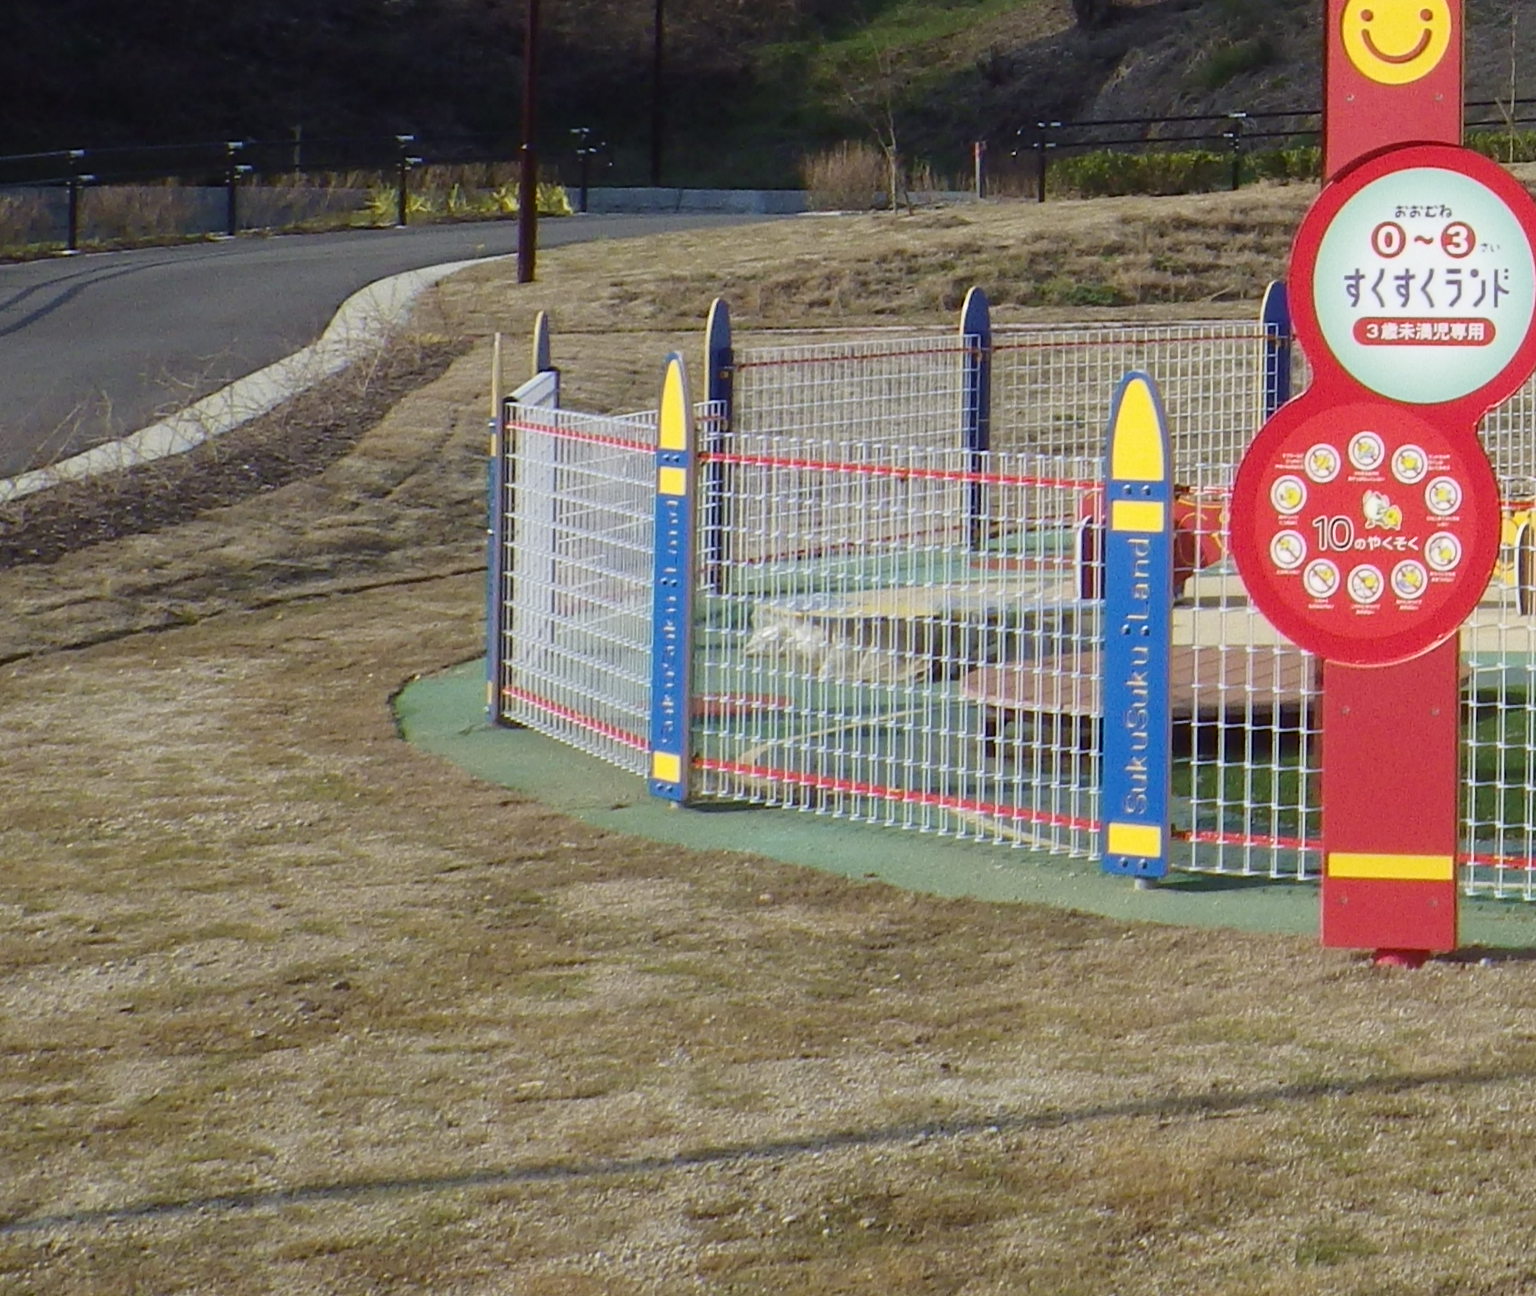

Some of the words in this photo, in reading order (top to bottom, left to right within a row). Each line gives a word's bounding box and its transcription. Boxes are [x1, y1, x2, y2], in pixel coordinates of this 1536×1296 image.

[1395, 204, 1453, 218] おおむね
[1344, 268, 1510, 308] すくすくランド
[1366, 322, 1485, 341] 3歳未満児専用
[1128, 538, 1151, 625] Land
[1123, 645, 1150, 816] SukuSuku
